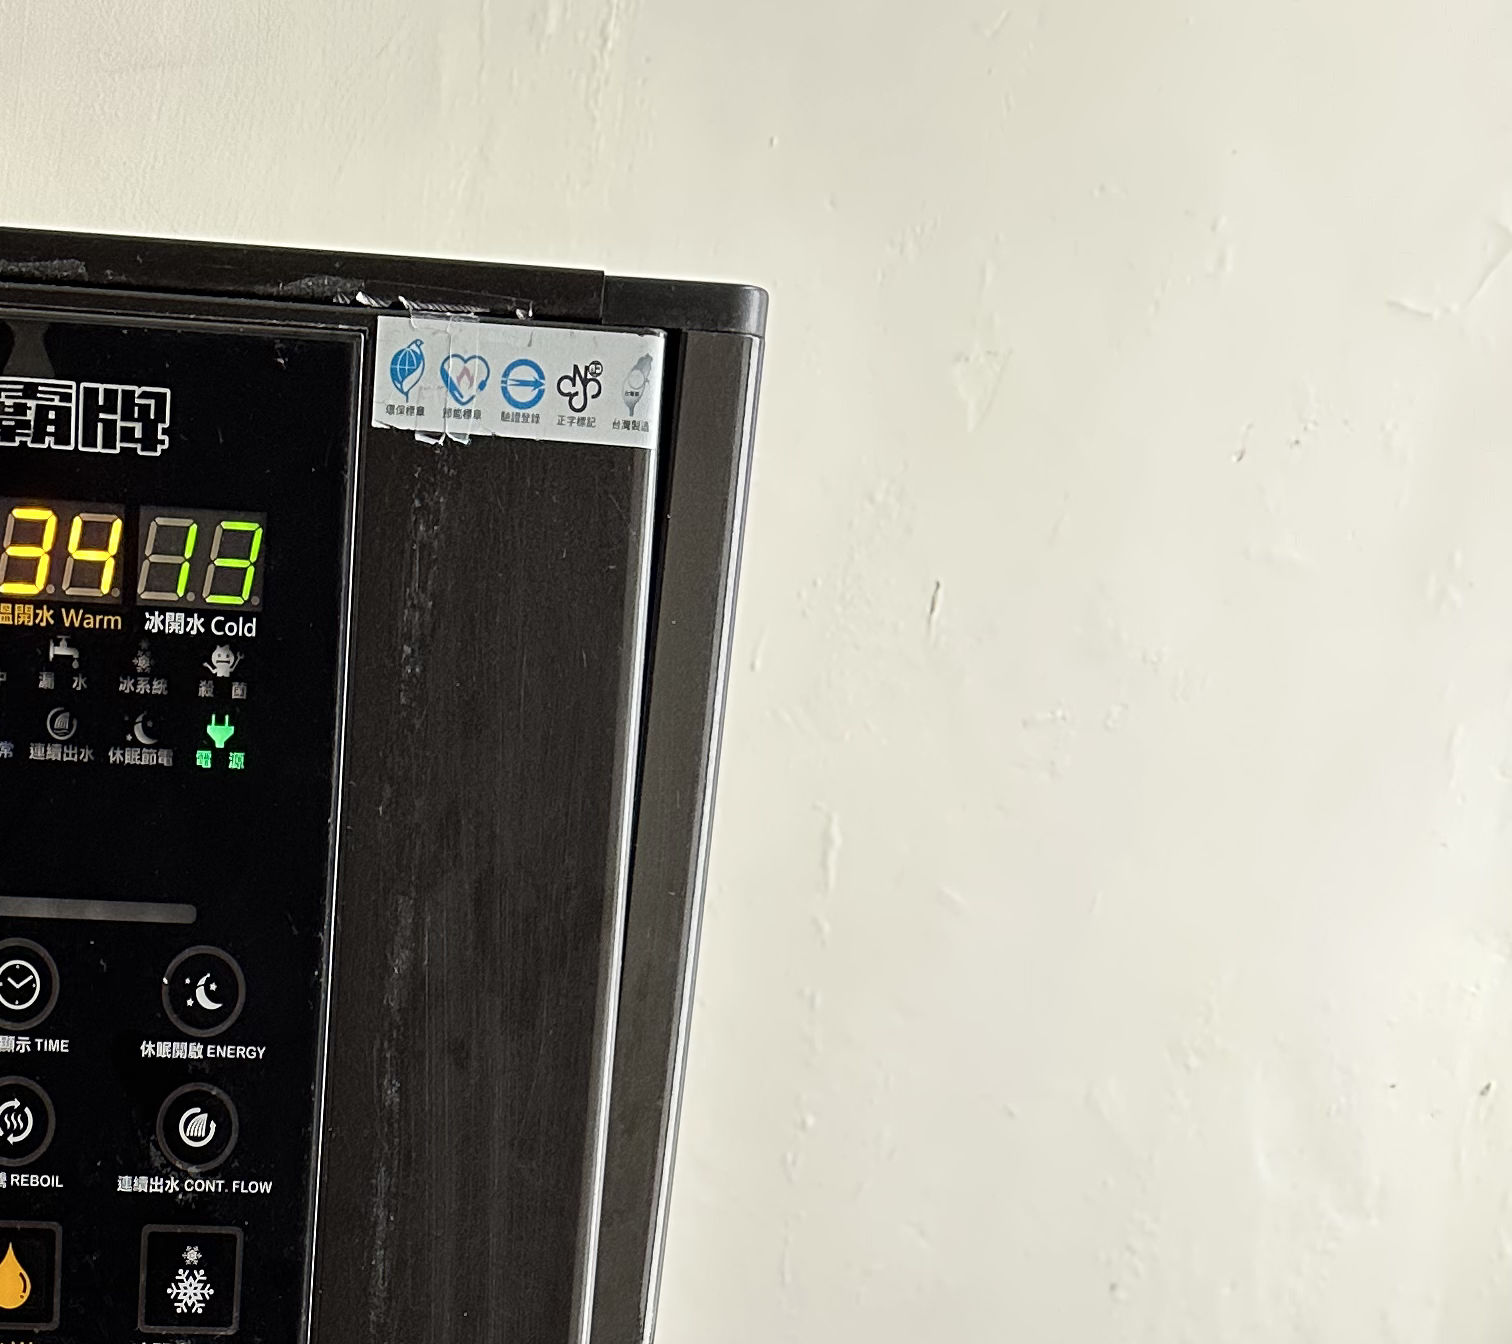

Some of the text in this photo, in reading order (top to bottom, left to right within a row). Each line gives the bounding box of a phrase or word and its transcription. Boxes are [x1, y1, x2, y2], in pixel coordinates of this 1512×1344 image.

[556, 414, 597, 429] 正字標記
[61, 608, 123, 630] Warm
[144, 610, 257, 637] 冰開水 Cold
[119, 676, 168, 695] 冰系統
[29, 742, 94, 763] 連續出水
[108, 746, 174, 767] 休眠節電
[35, 1038, 70, 1052] TIME
[140, 1040, 266, 1060] 休眠開啟 ENERGY
[10, 1174, 64, 1188] REBOIL
[117, 1175, 273, 1194] 連續出水 CONT. FLOW
